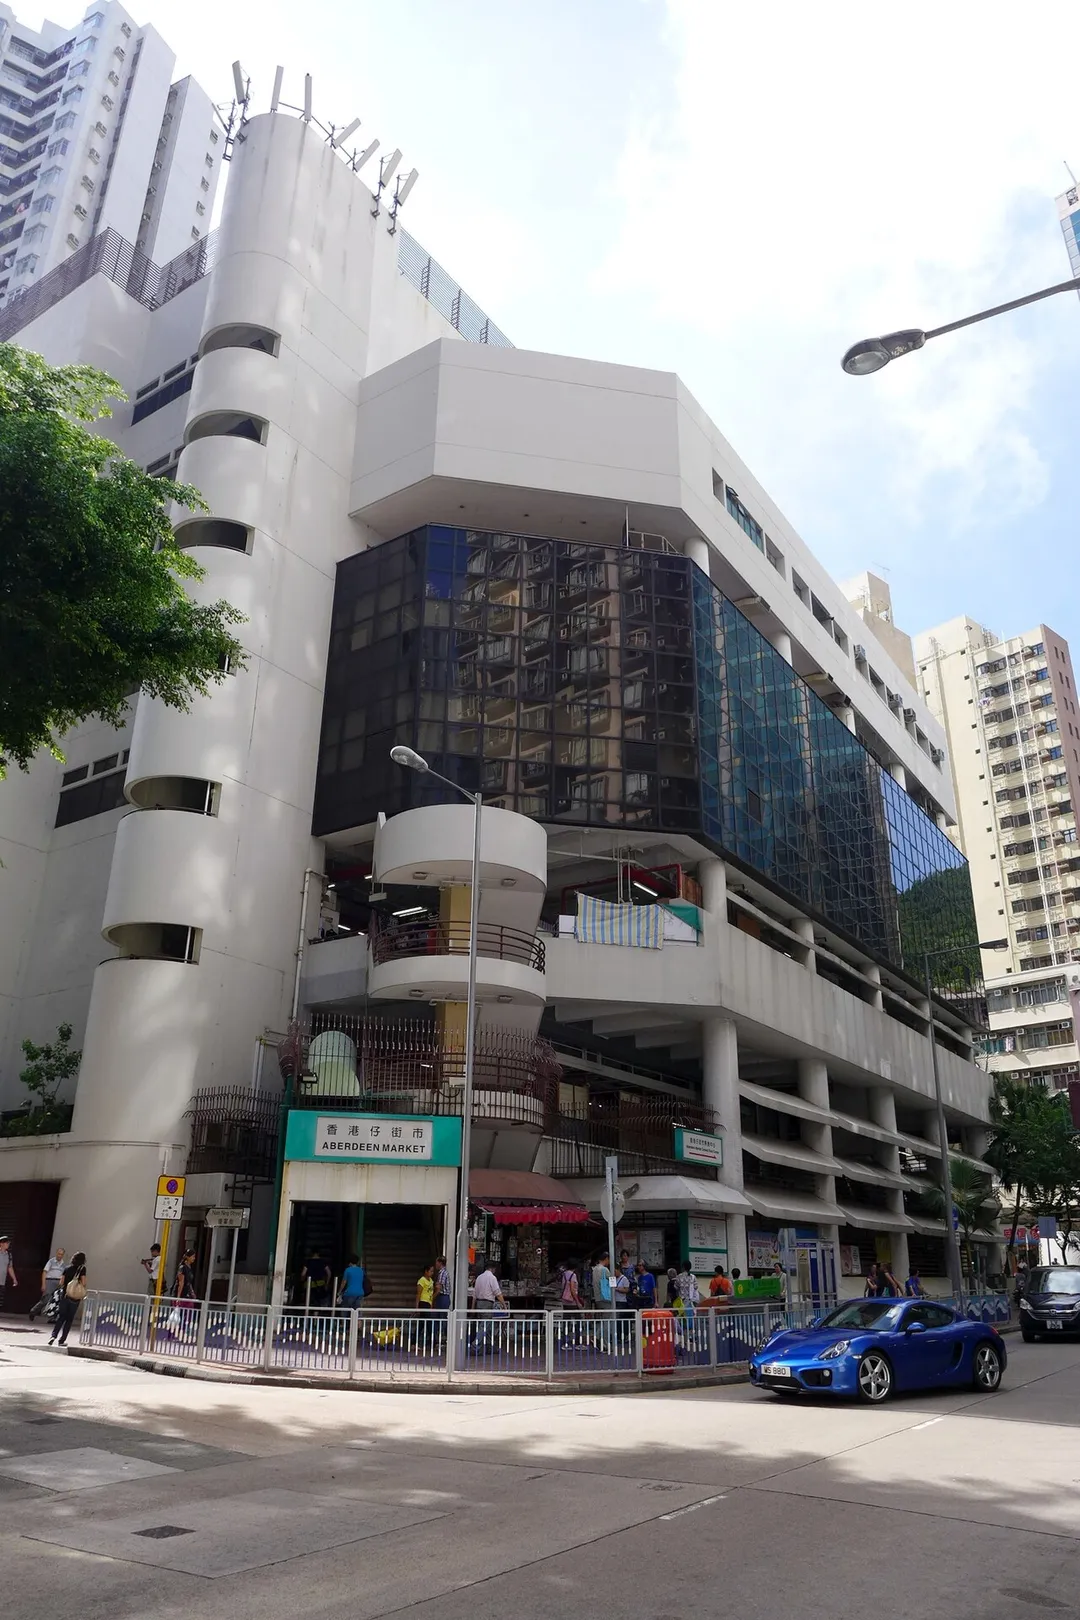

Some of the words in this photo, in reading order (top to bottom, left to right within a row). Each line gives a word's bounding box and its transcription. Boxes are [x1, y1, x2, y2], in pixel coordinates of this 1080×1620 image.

[326, 1124, 423, 1139] 香港仔街市
[322, 1141, 380, 1152] ABERDEEN
[382, 1144, 426, 1153] MARKET
[174, 1198, 179, 1206] 7
[173, 1210, 178, 1218] 7
